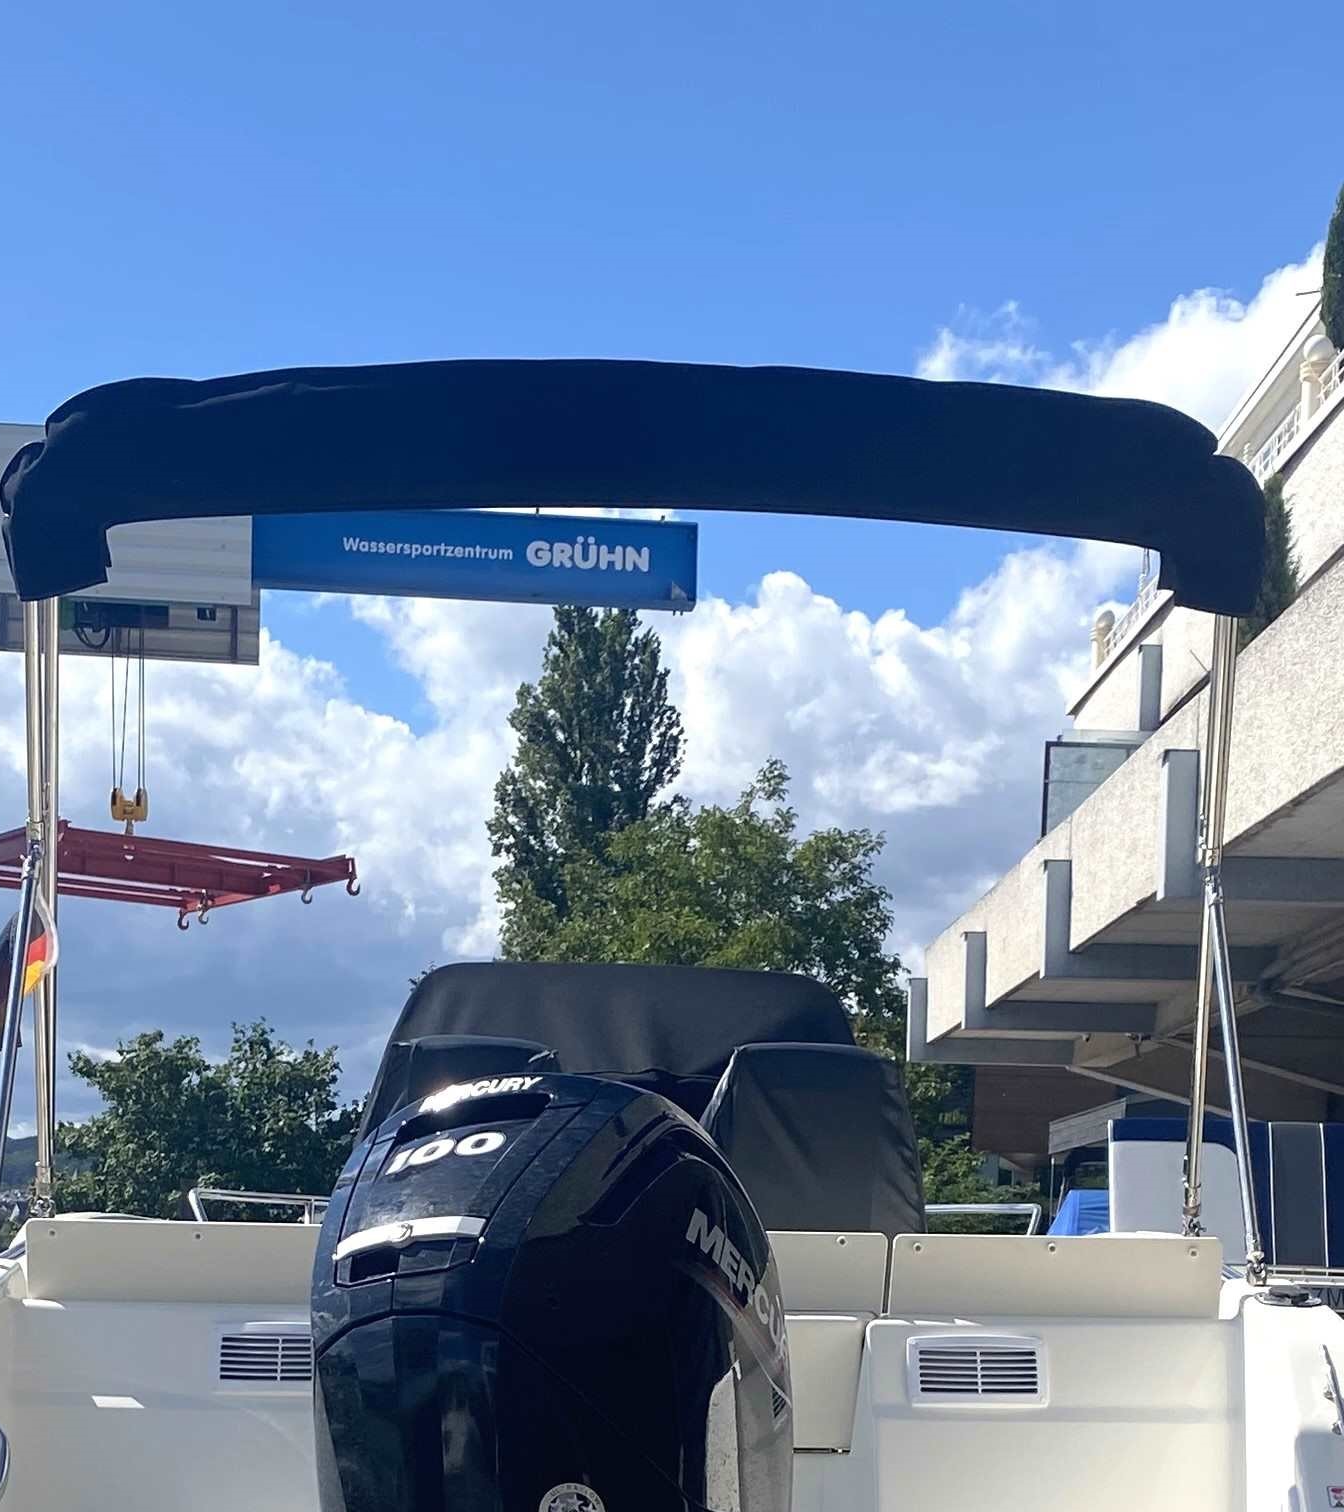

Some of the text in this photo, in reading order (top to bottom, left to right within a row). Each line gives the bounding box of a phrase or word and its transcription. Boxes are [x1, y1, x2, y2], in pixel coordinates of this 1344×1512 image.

[343, 535, 650, 572] Wassersportzentrum GRÜHN
[418, 1076, 543, 1113] MCURY
[384, 1132, 506, 1175] 100
